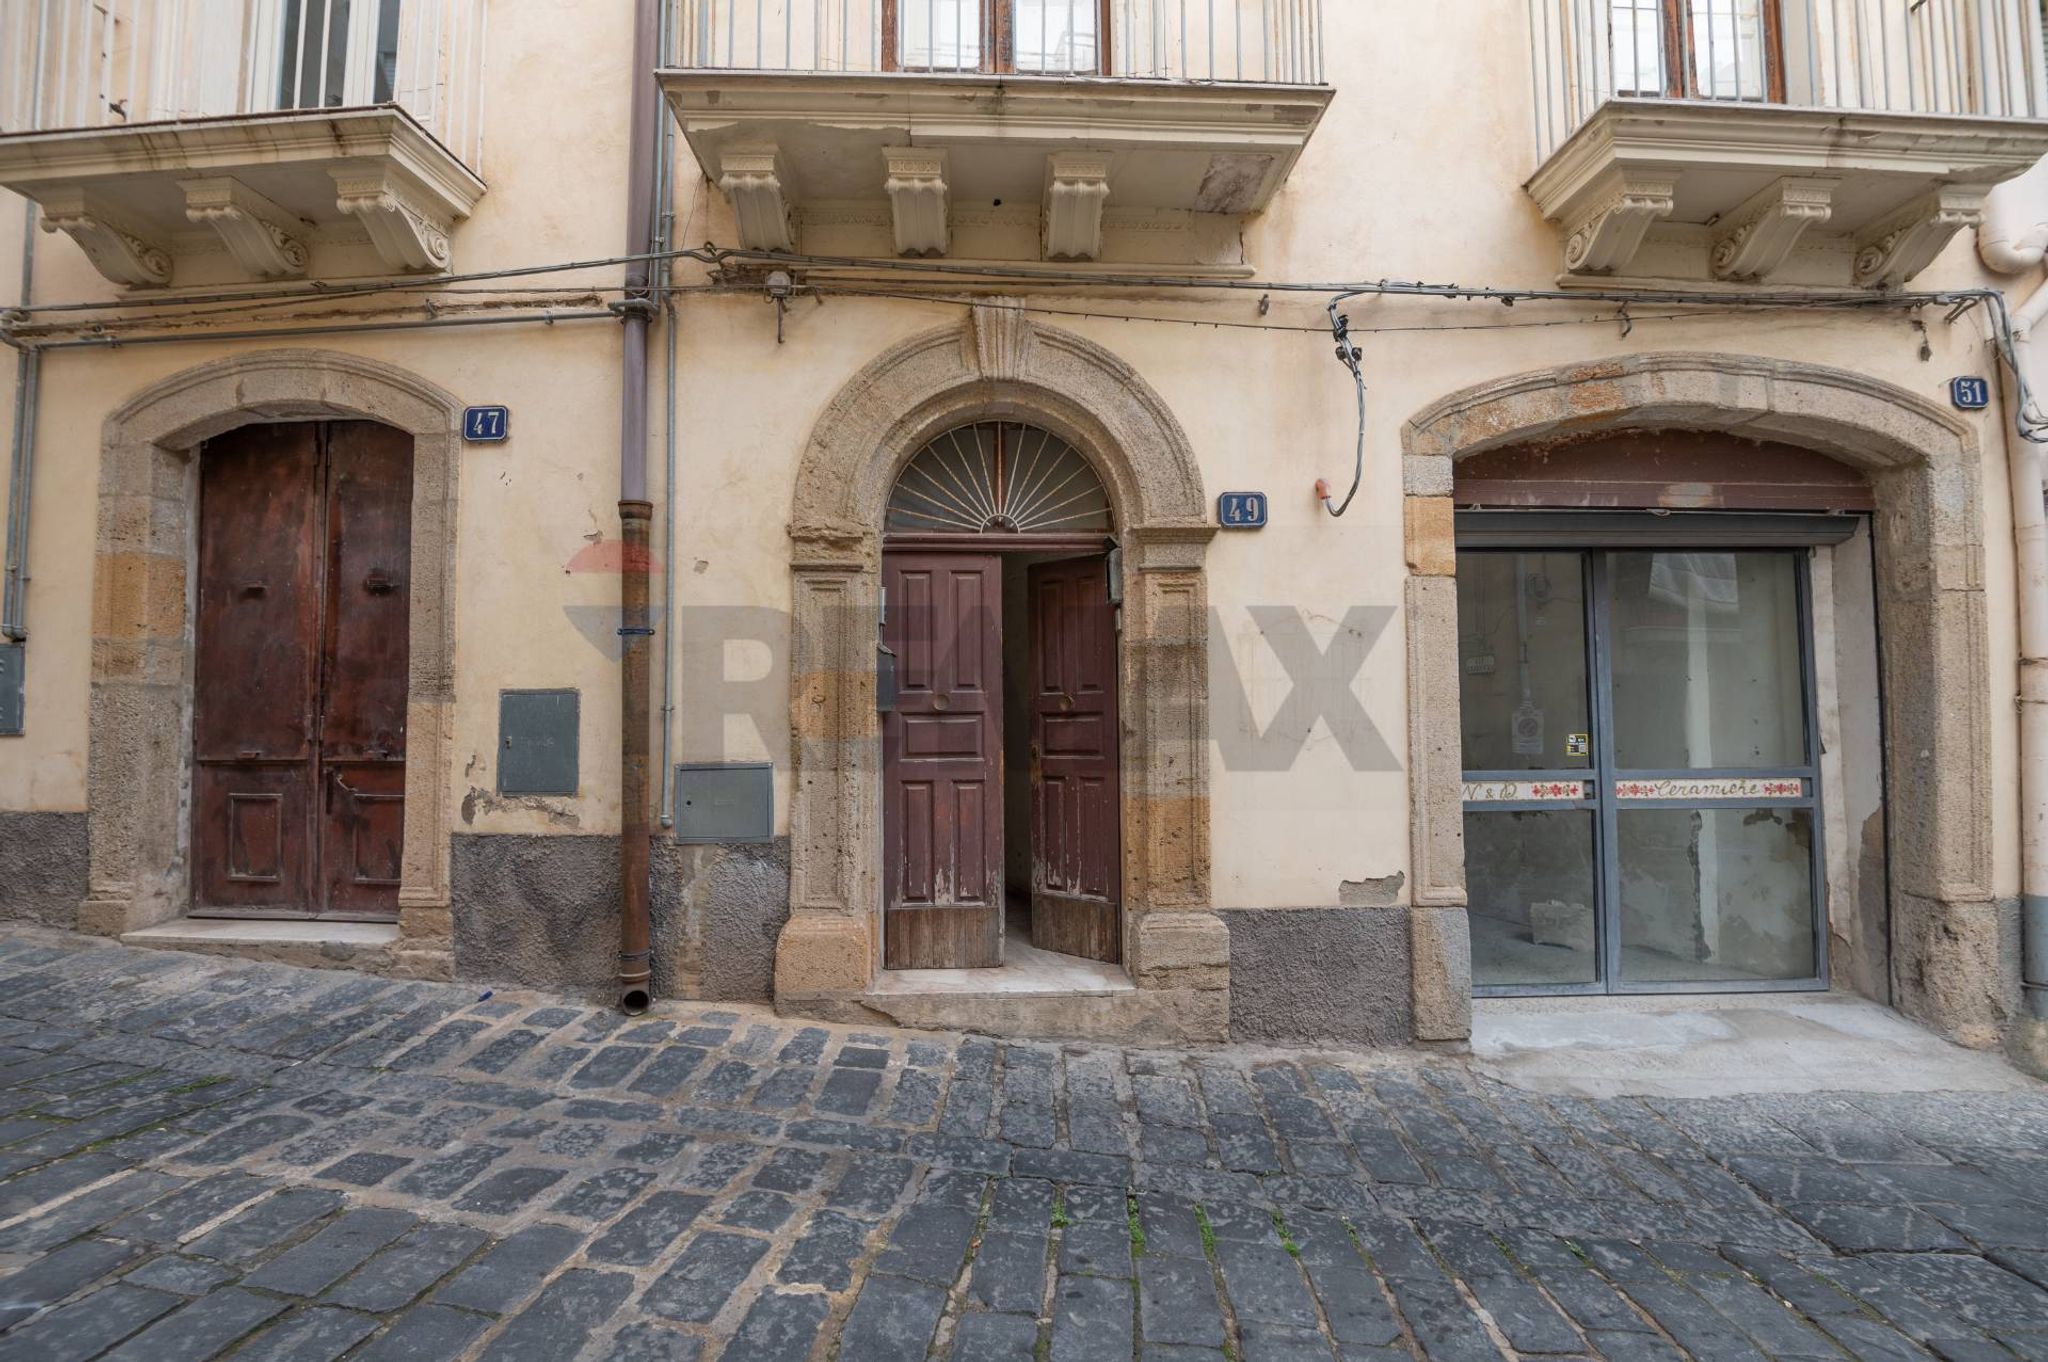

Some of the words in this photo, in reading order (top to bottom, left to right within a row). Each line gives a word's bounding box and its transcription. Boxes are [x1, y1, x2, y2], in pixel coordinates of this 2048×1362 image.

[1960, 381, 1982, 403] 51
[473, 411, 500, 434] 47
[1228, 497, 1259, 521] 49
[1485, 787, 1495, 799] &
[1654, 779, 1760, 797] Ceramiche
